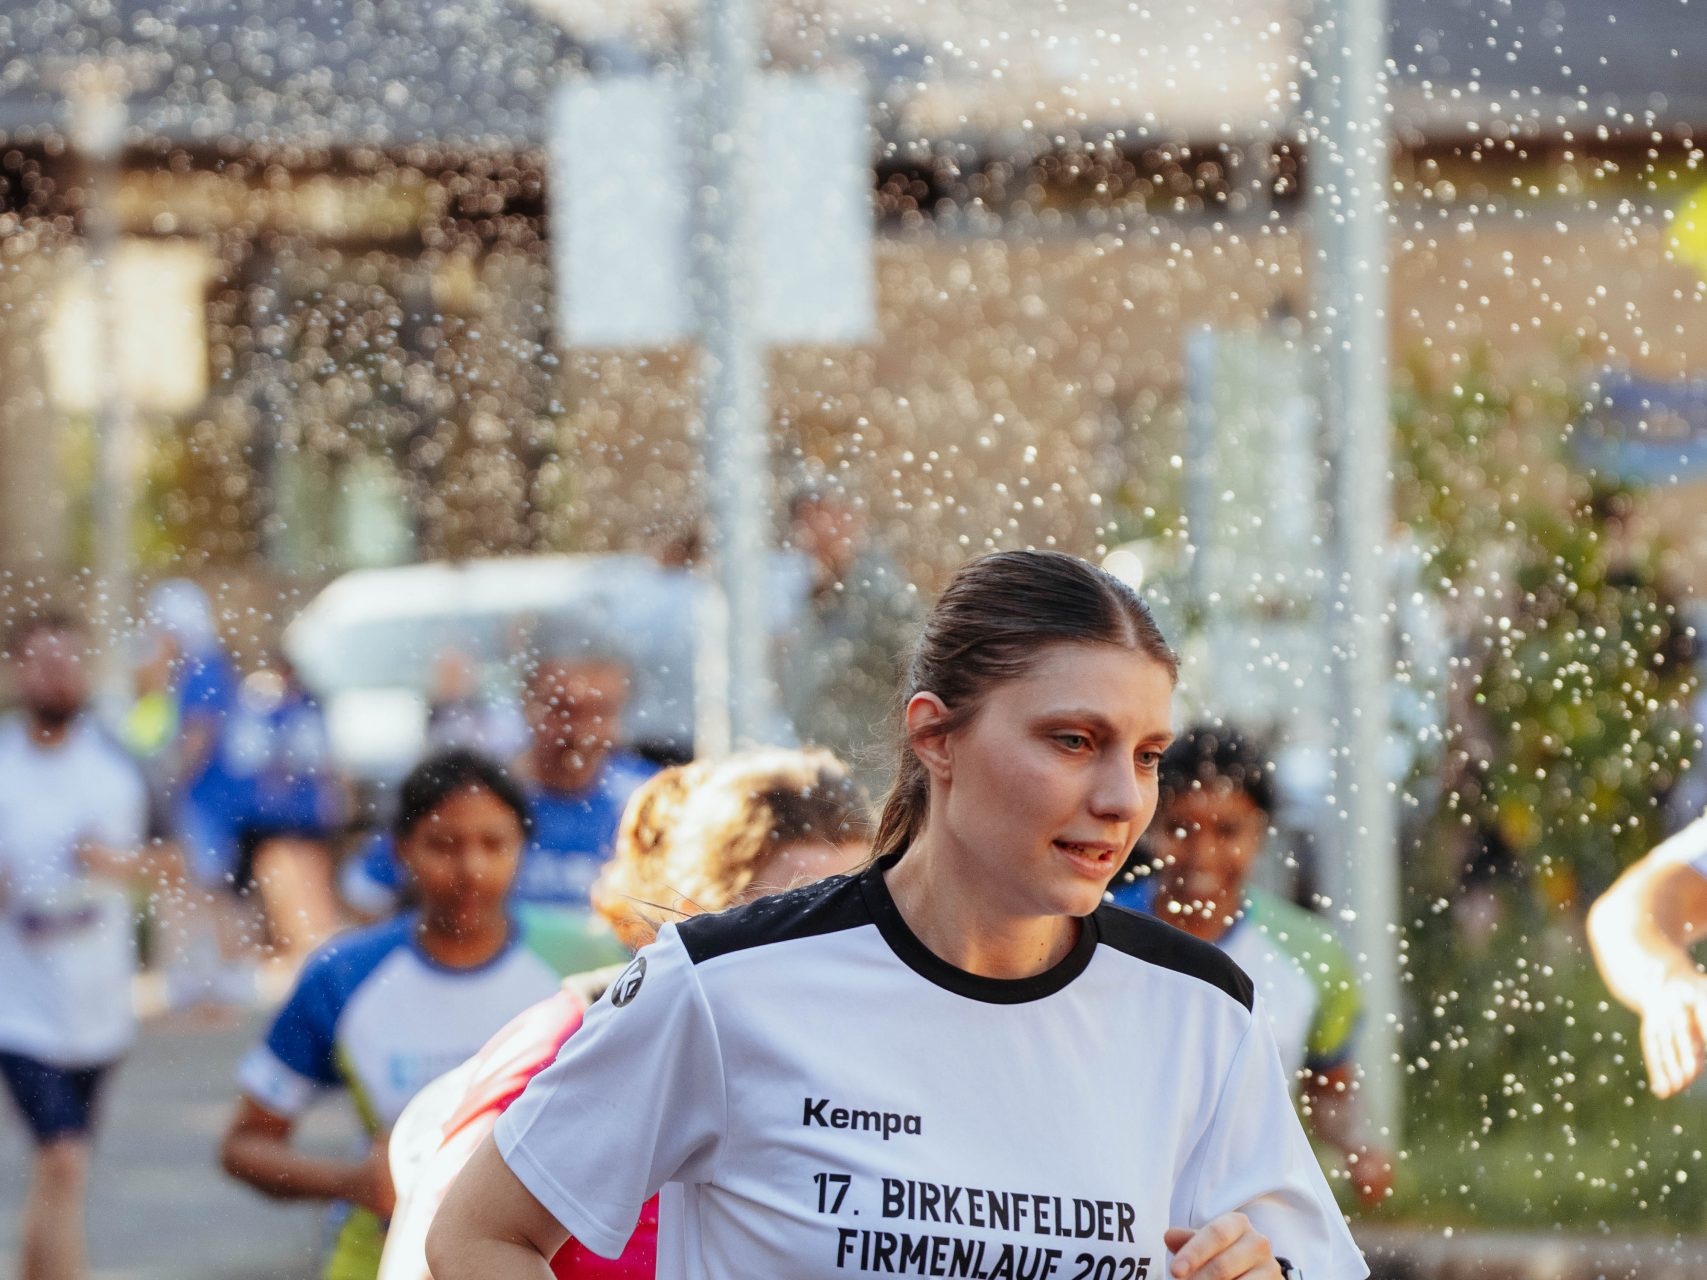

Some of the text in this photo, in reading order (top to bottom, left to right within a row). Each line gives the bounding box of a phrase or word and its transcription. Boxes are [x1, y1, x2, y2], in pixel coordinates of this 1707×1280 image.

[802, 1097, 922, 1140] Kempa
[813, 1172, 1136, 1243] 17. BIRKENFELDER
